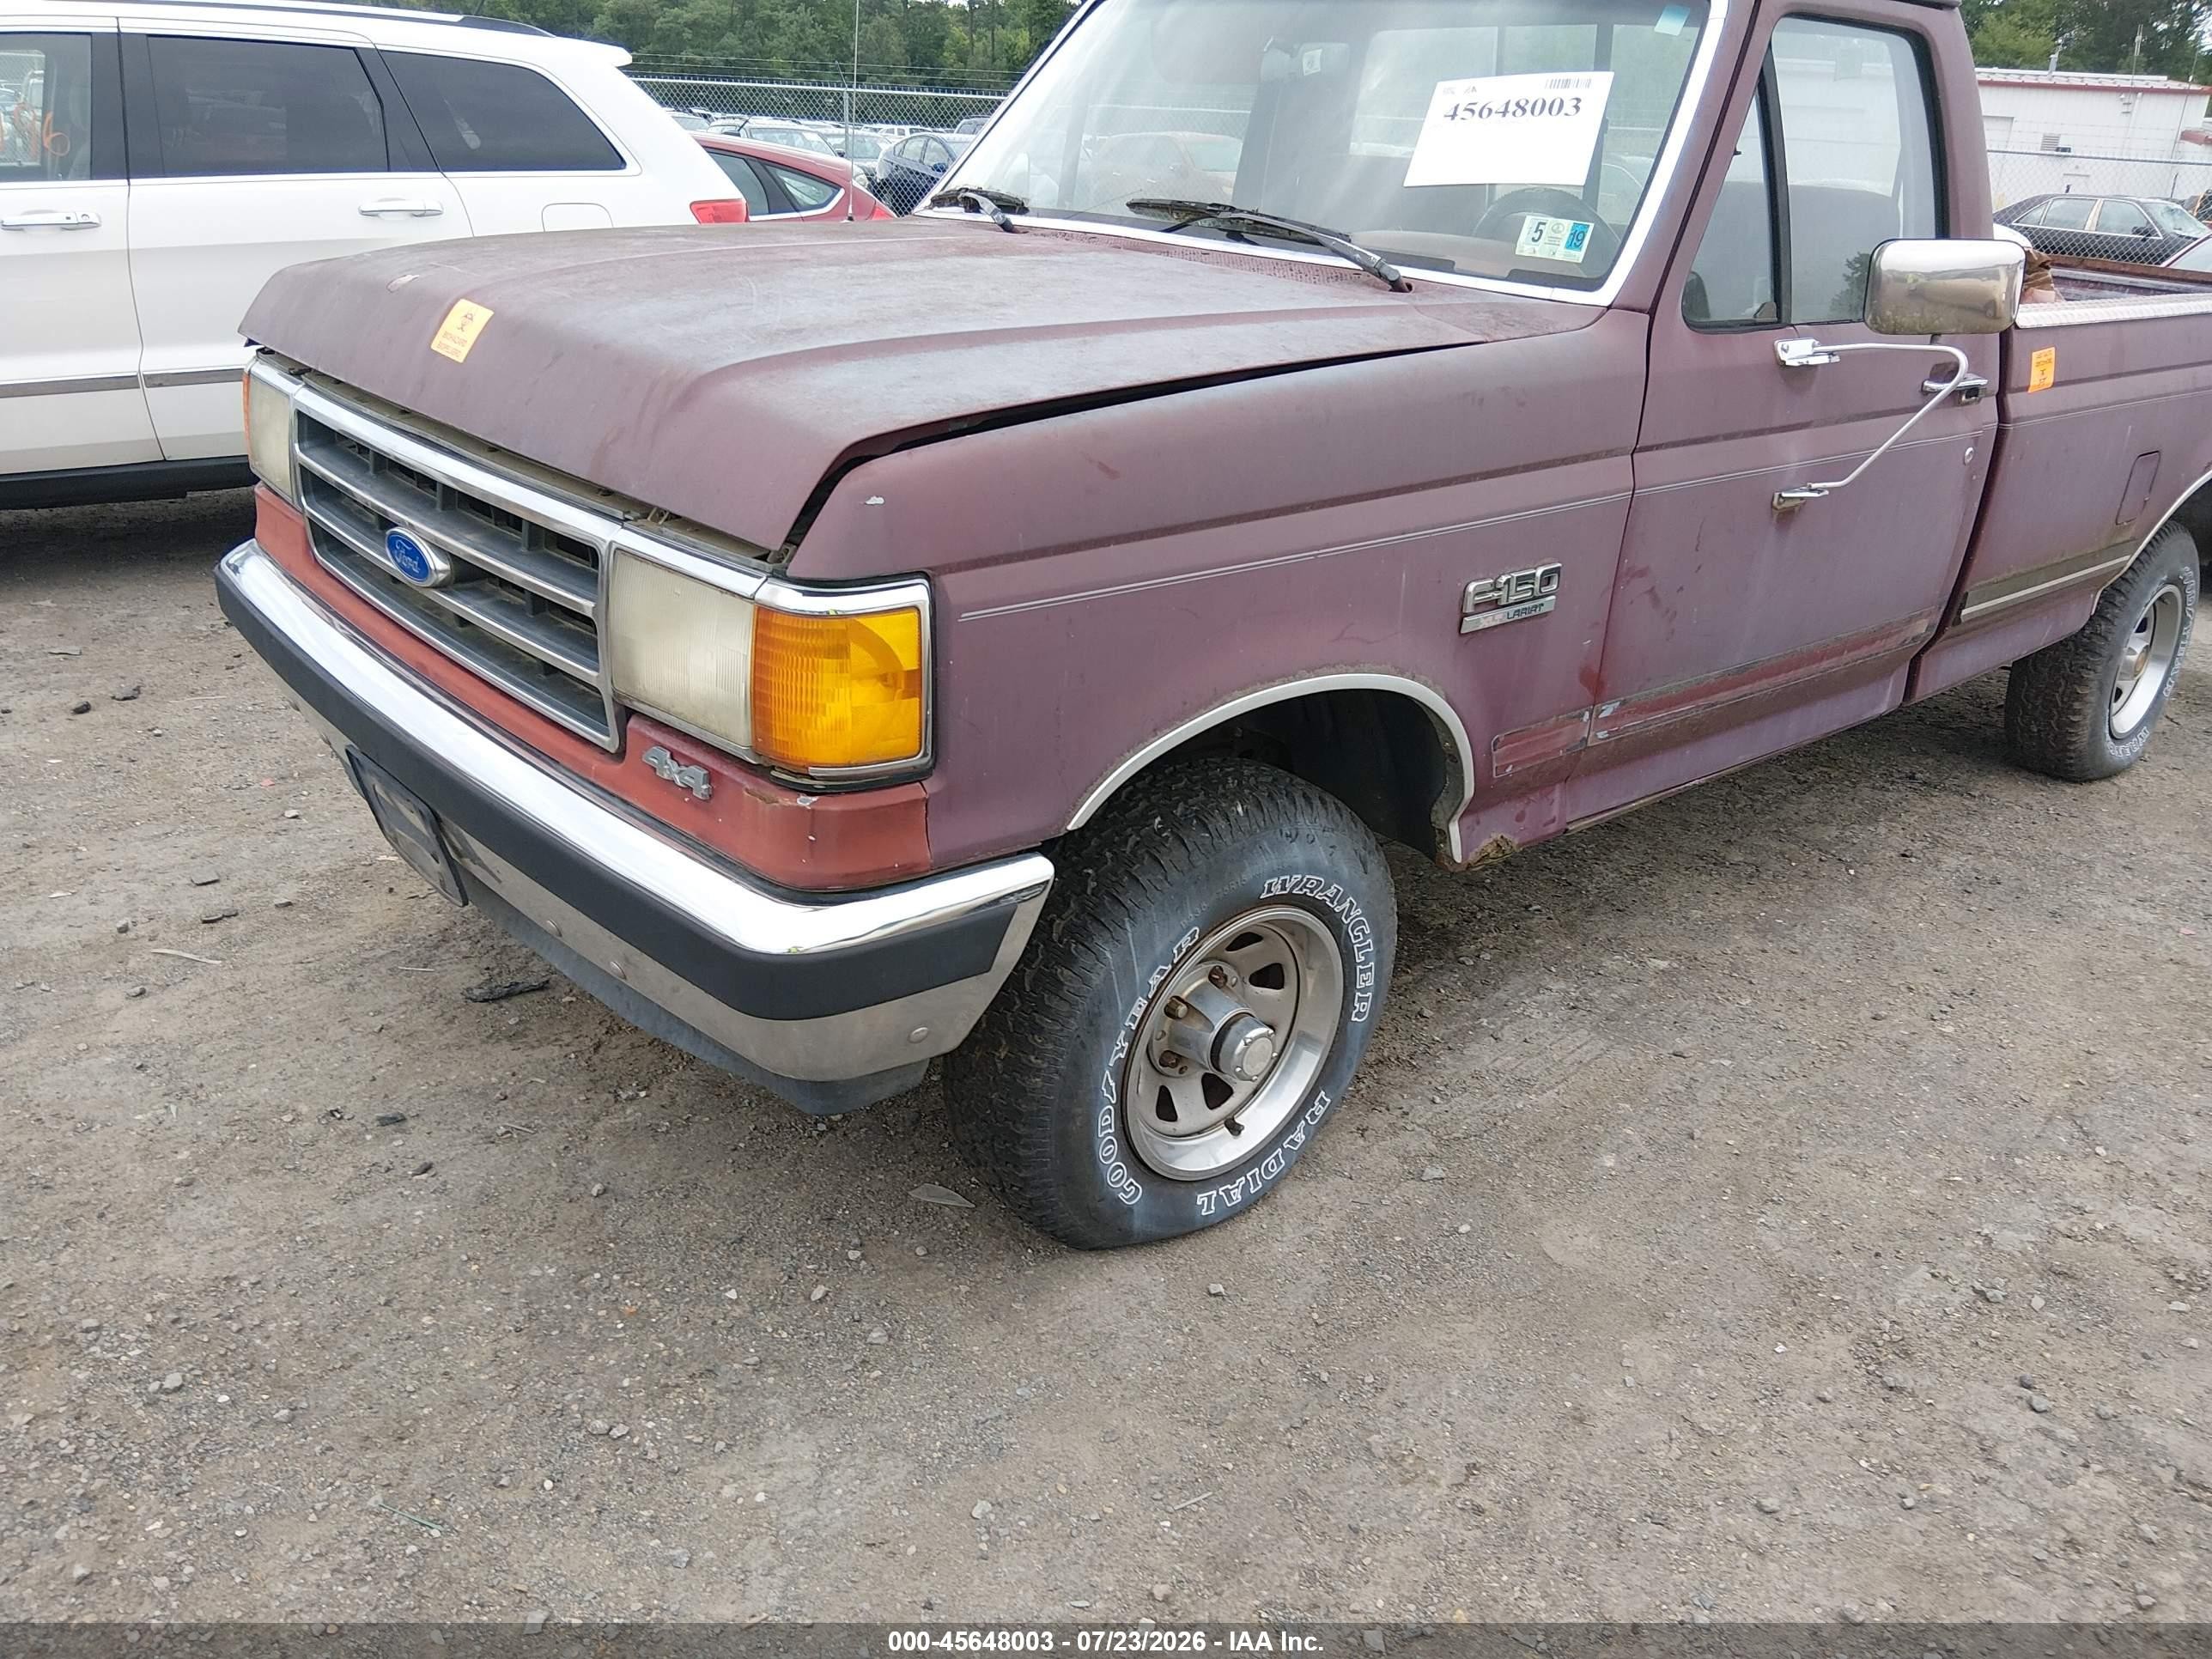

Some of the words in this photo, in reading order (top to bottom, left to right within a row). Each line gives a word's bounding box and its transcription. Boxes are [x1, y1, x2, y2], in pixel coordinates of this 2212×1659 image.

[1443, 96, 1583, 121] 45648003
[1531, 221, 1547, 243] 5
[1569, 228, 1587, 248] 19
[392, 538, 422, 574] Ford
[1462, 562, 1563, 613] F-150
[1506, 602, 1545, 620] LARIAT
[1259, 874, 1376, 1023] WRANGLER
[1098, 927, 1200, 1206] GOODYEAR
[1196, 1091, 1332, 1216] RADIAL
